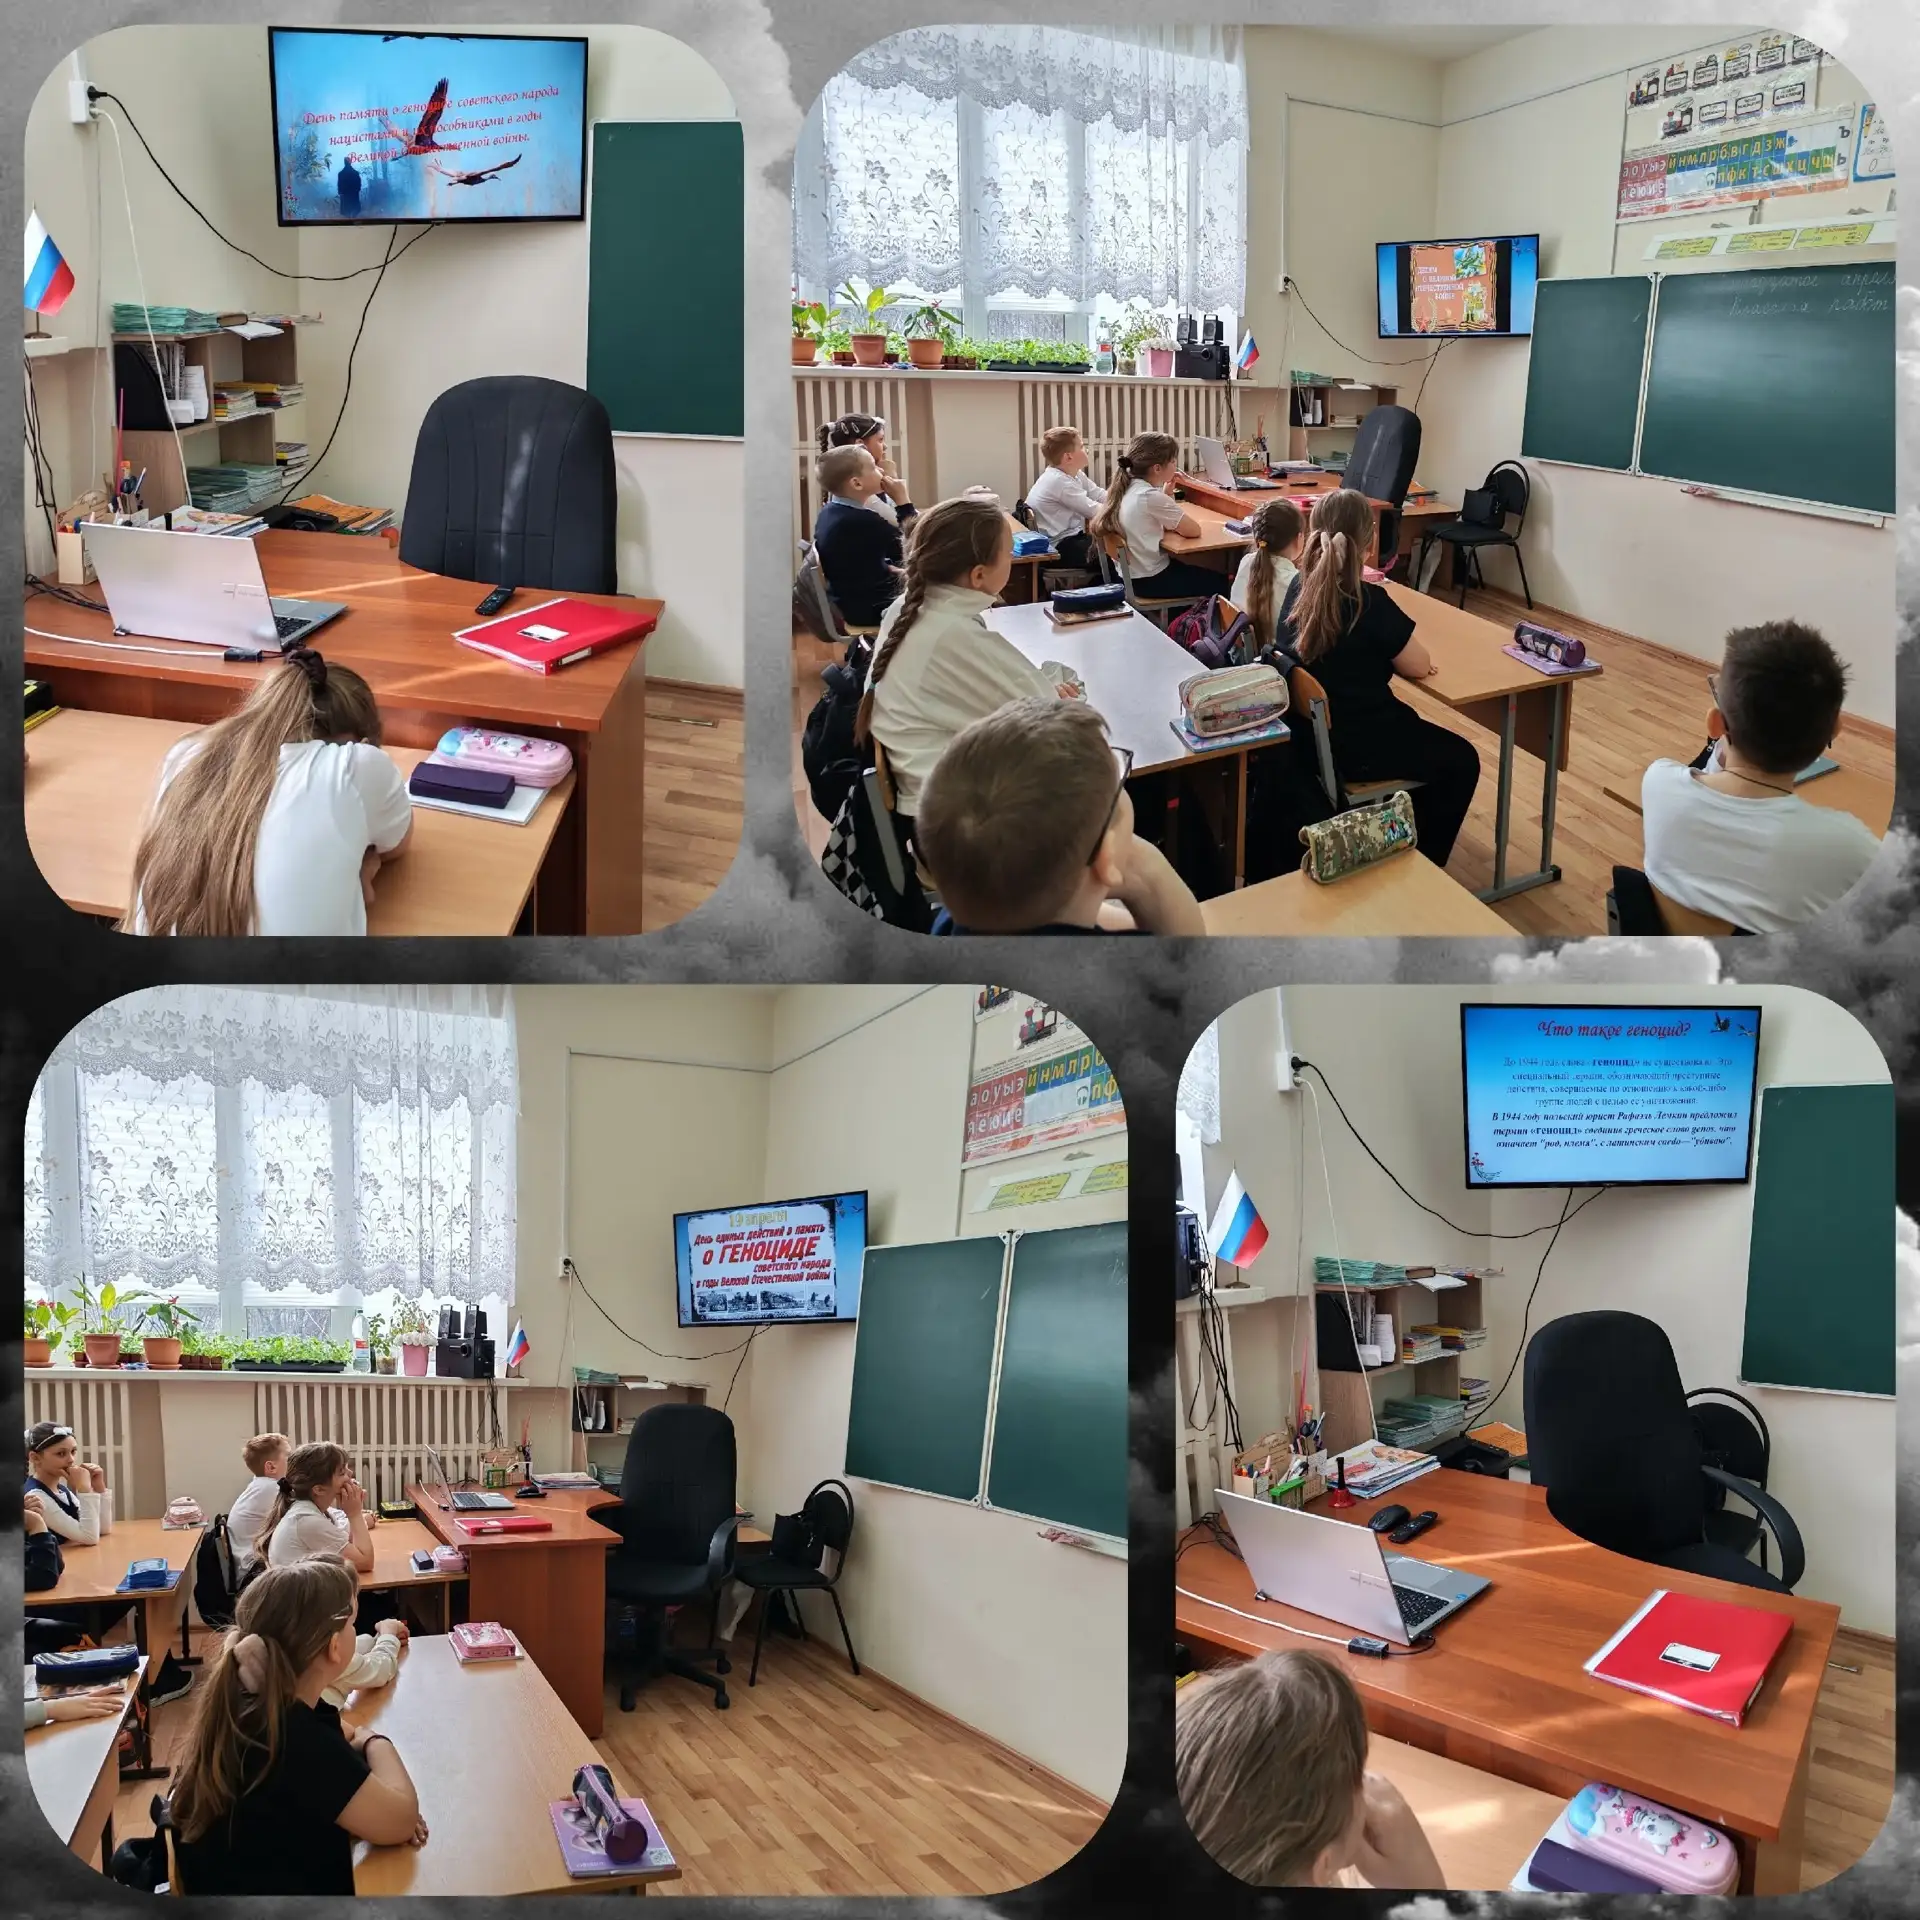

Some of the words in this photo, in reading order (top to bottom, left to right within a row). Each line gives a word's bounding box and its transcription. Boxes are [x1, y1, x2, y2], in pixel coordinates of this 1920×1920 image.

[304, 112, 335, 125] День
[340, 108, 388, 120] памяти
[392, 106, 399, 114] о
[457, 92, 519, 108] советского
[522, 85, 559, 102] народа
[516, 110, 542, 122] годы
[348, 148, 397, 164] Великой
[493, 134, 530, 146] войны.
[1538, 1020, 1574, 1036] Что
[1578, 1024, 1622, 1040] такое
[1626, 1020, 1692, 1039] геноцид?
[1492, 1112, 1498, 1120] В
[1501, 1112, 1521, 1120] 1944
[729, 1212, 744, 1228] 19
[694, 1234, 713, 1246] День
[716, 1232, 746, 1244] единых
[747, 1226, 784, 1240] действий
[795, 1224, 825, 1236] память
[719, 1236, 820, 1264] ГЕНОЦИДЕ
[754, 1262, 798, 1273] советского
[801, 1258, 831, 1270] народа
[702, 1278, 718, 1288] годы
[806, 1271, 830, 1281] войны
